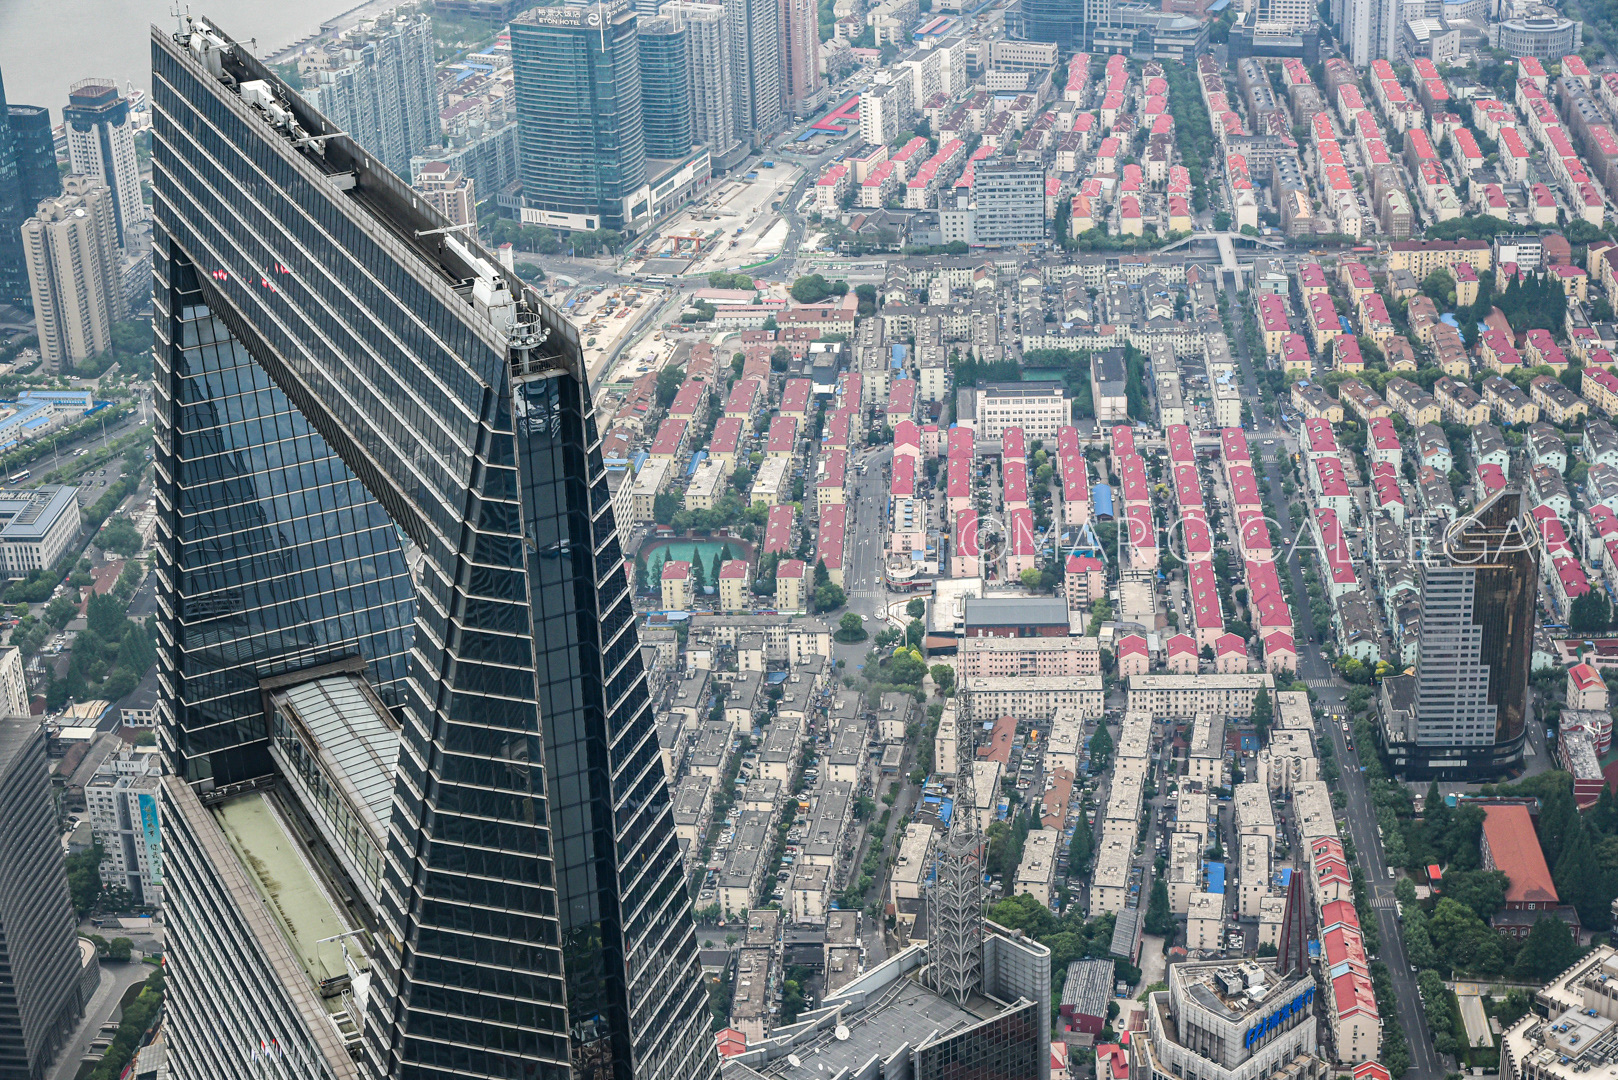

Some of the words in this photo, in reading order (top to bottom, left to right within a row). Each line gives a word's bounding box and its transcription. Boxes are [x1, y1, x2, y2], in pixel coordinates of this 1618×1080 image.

[539, 17, 558, 25] ETON
[1267, 986, 1316, 1031] 浦发银行
